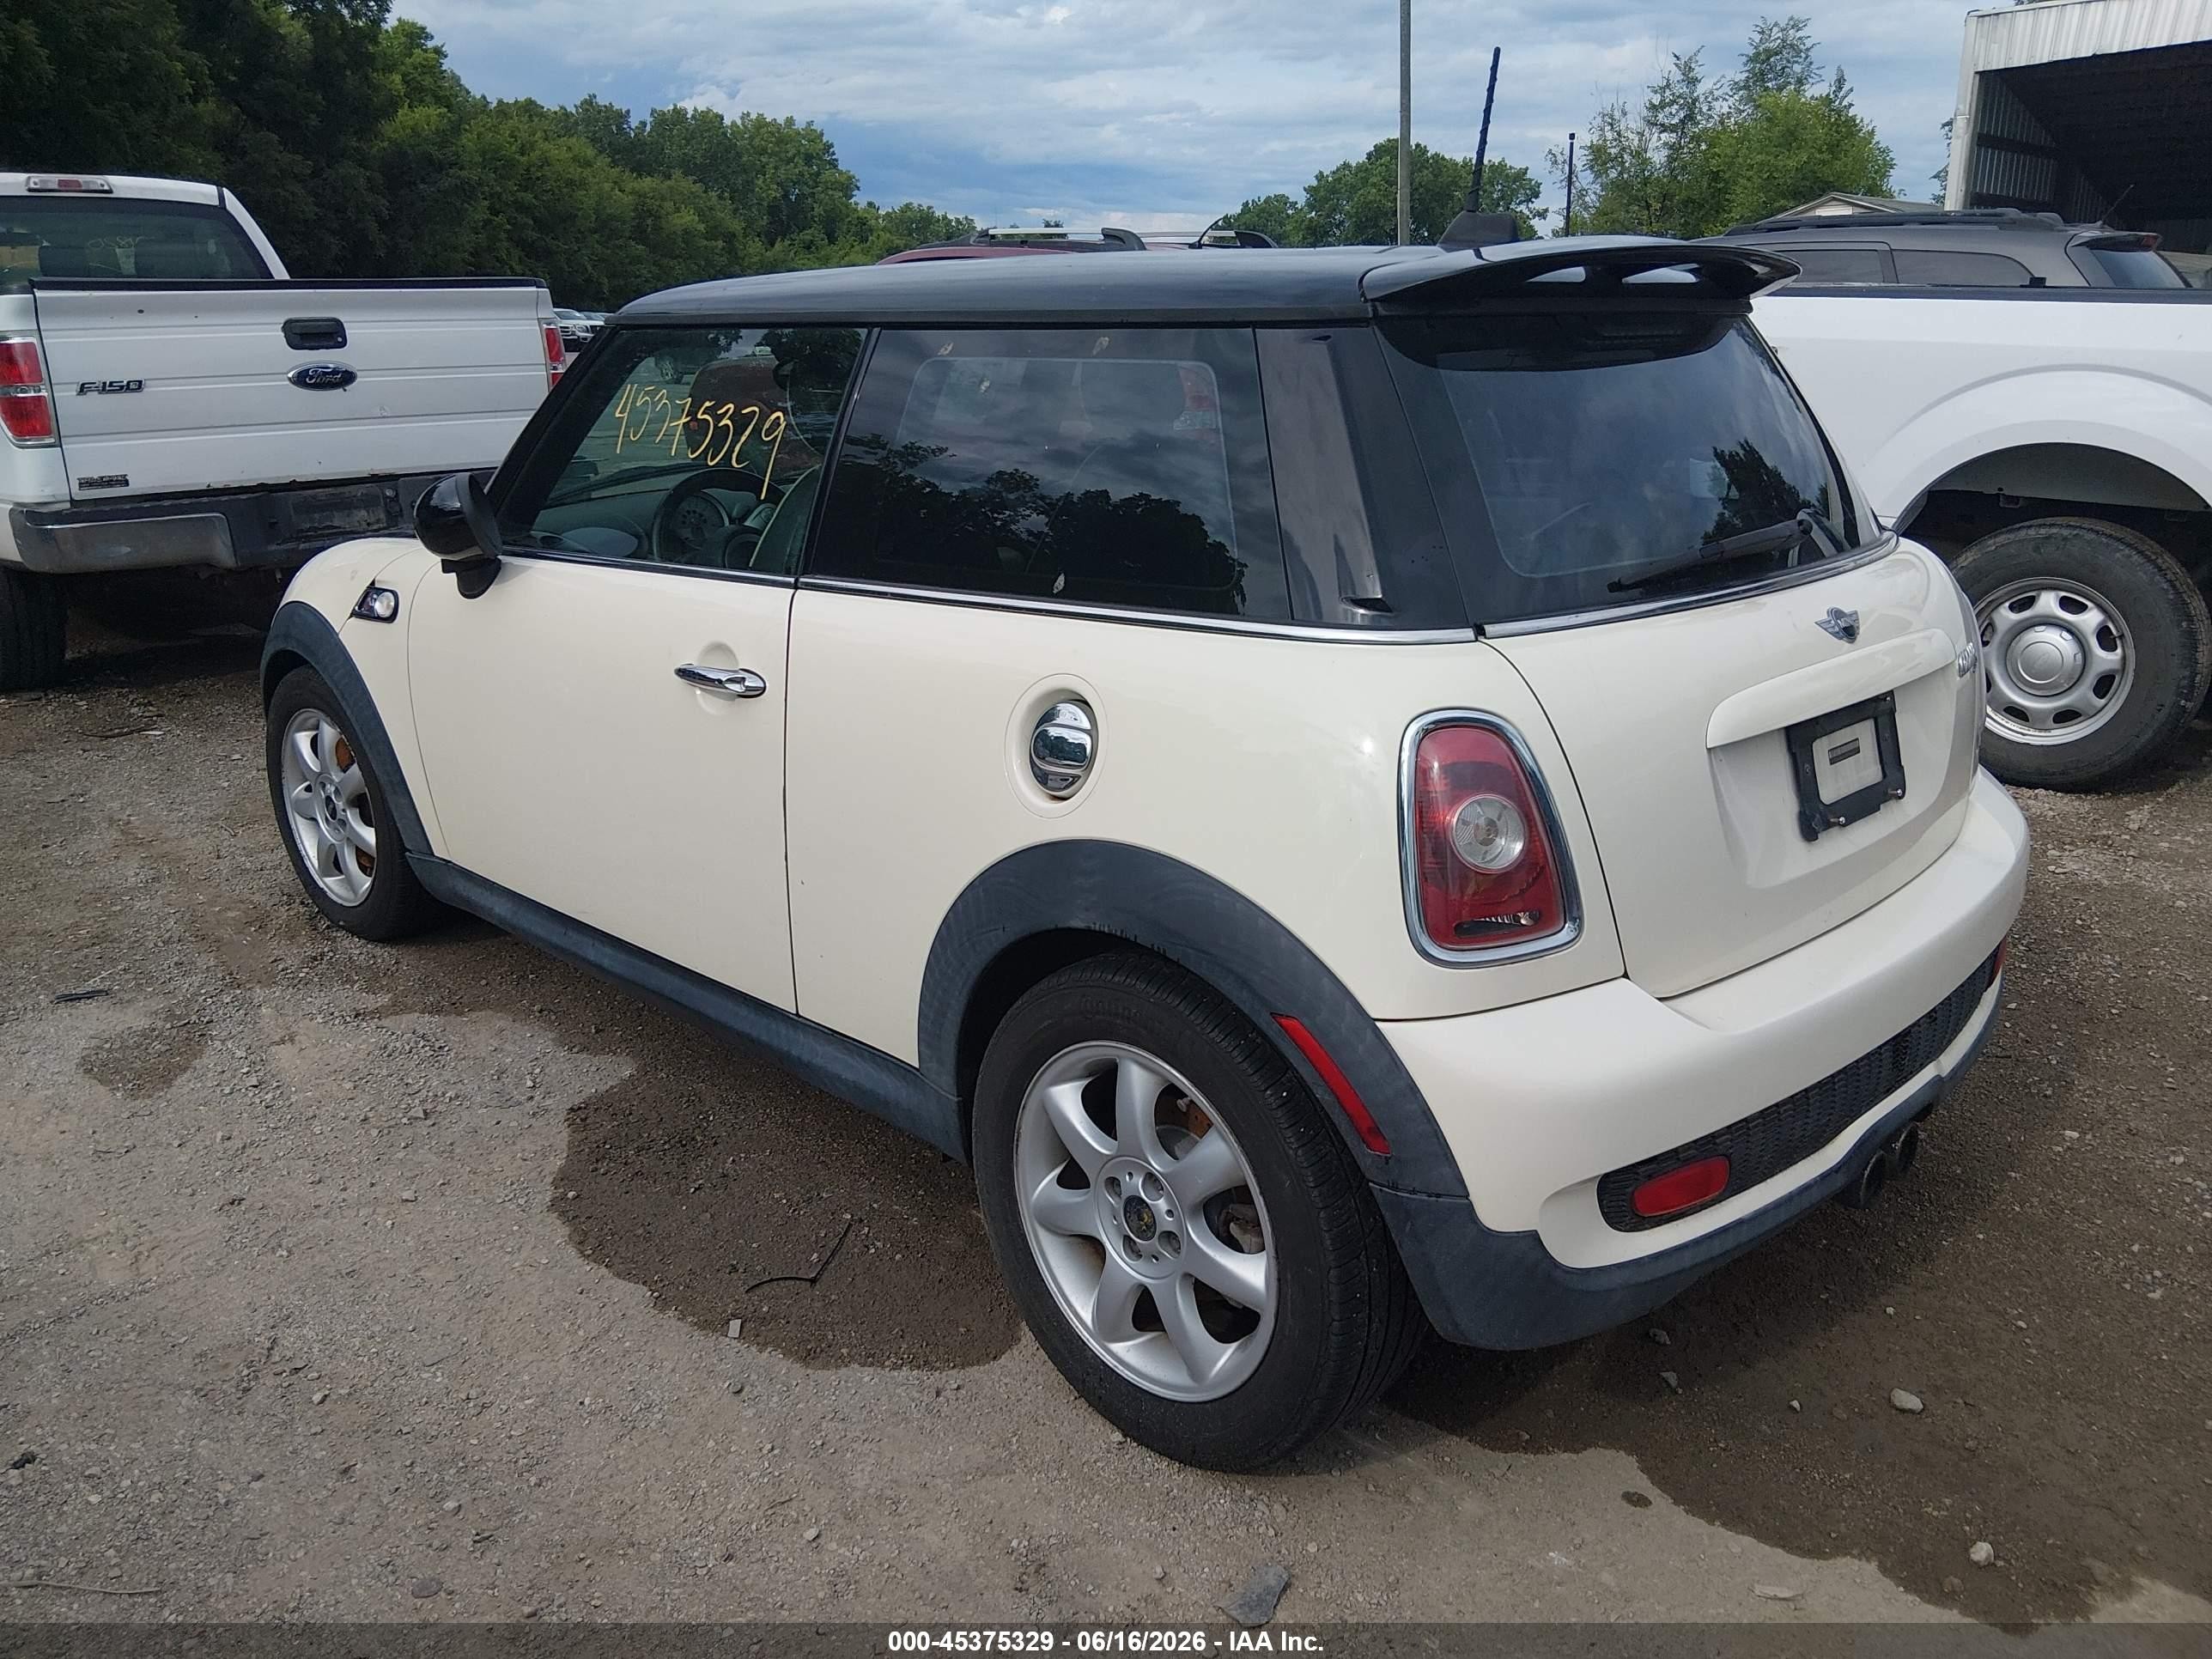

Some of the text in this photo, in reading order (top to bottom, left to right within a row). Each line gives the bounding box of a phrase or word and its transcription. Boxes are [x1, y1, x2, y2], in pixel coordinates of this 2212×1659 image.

[306, 368, 343, 384] Ford
[76, 379, 144, 396] F-150
[615, 384, 787, 501] 45375329
